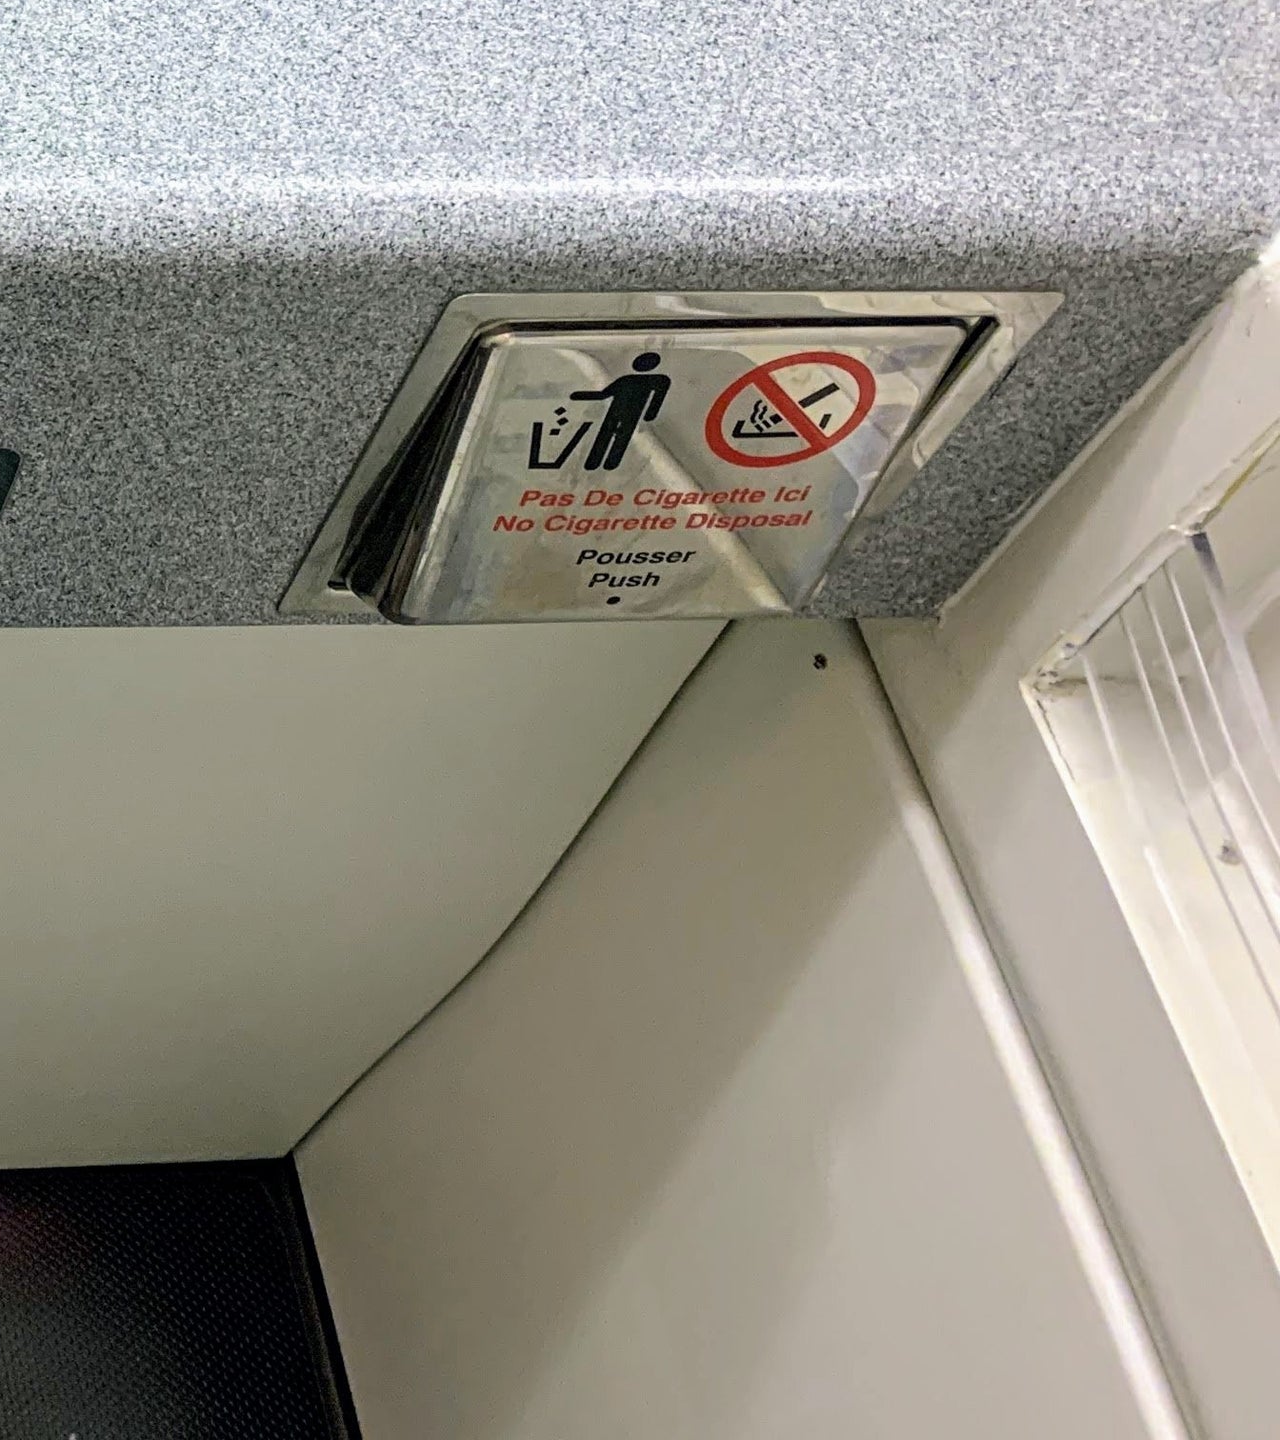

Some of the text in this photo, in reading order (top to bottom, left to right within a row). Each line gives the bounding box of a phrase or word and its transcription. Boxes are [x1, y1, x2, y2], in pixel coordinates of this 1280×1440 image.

[519, 485, 812, 509] Pas De Cigarette Ici
[493, 510, 813, 536] No Cigarette Disposal
[576, 549, 697, 565] Pousser
[588, 571, 661, 588] Push
